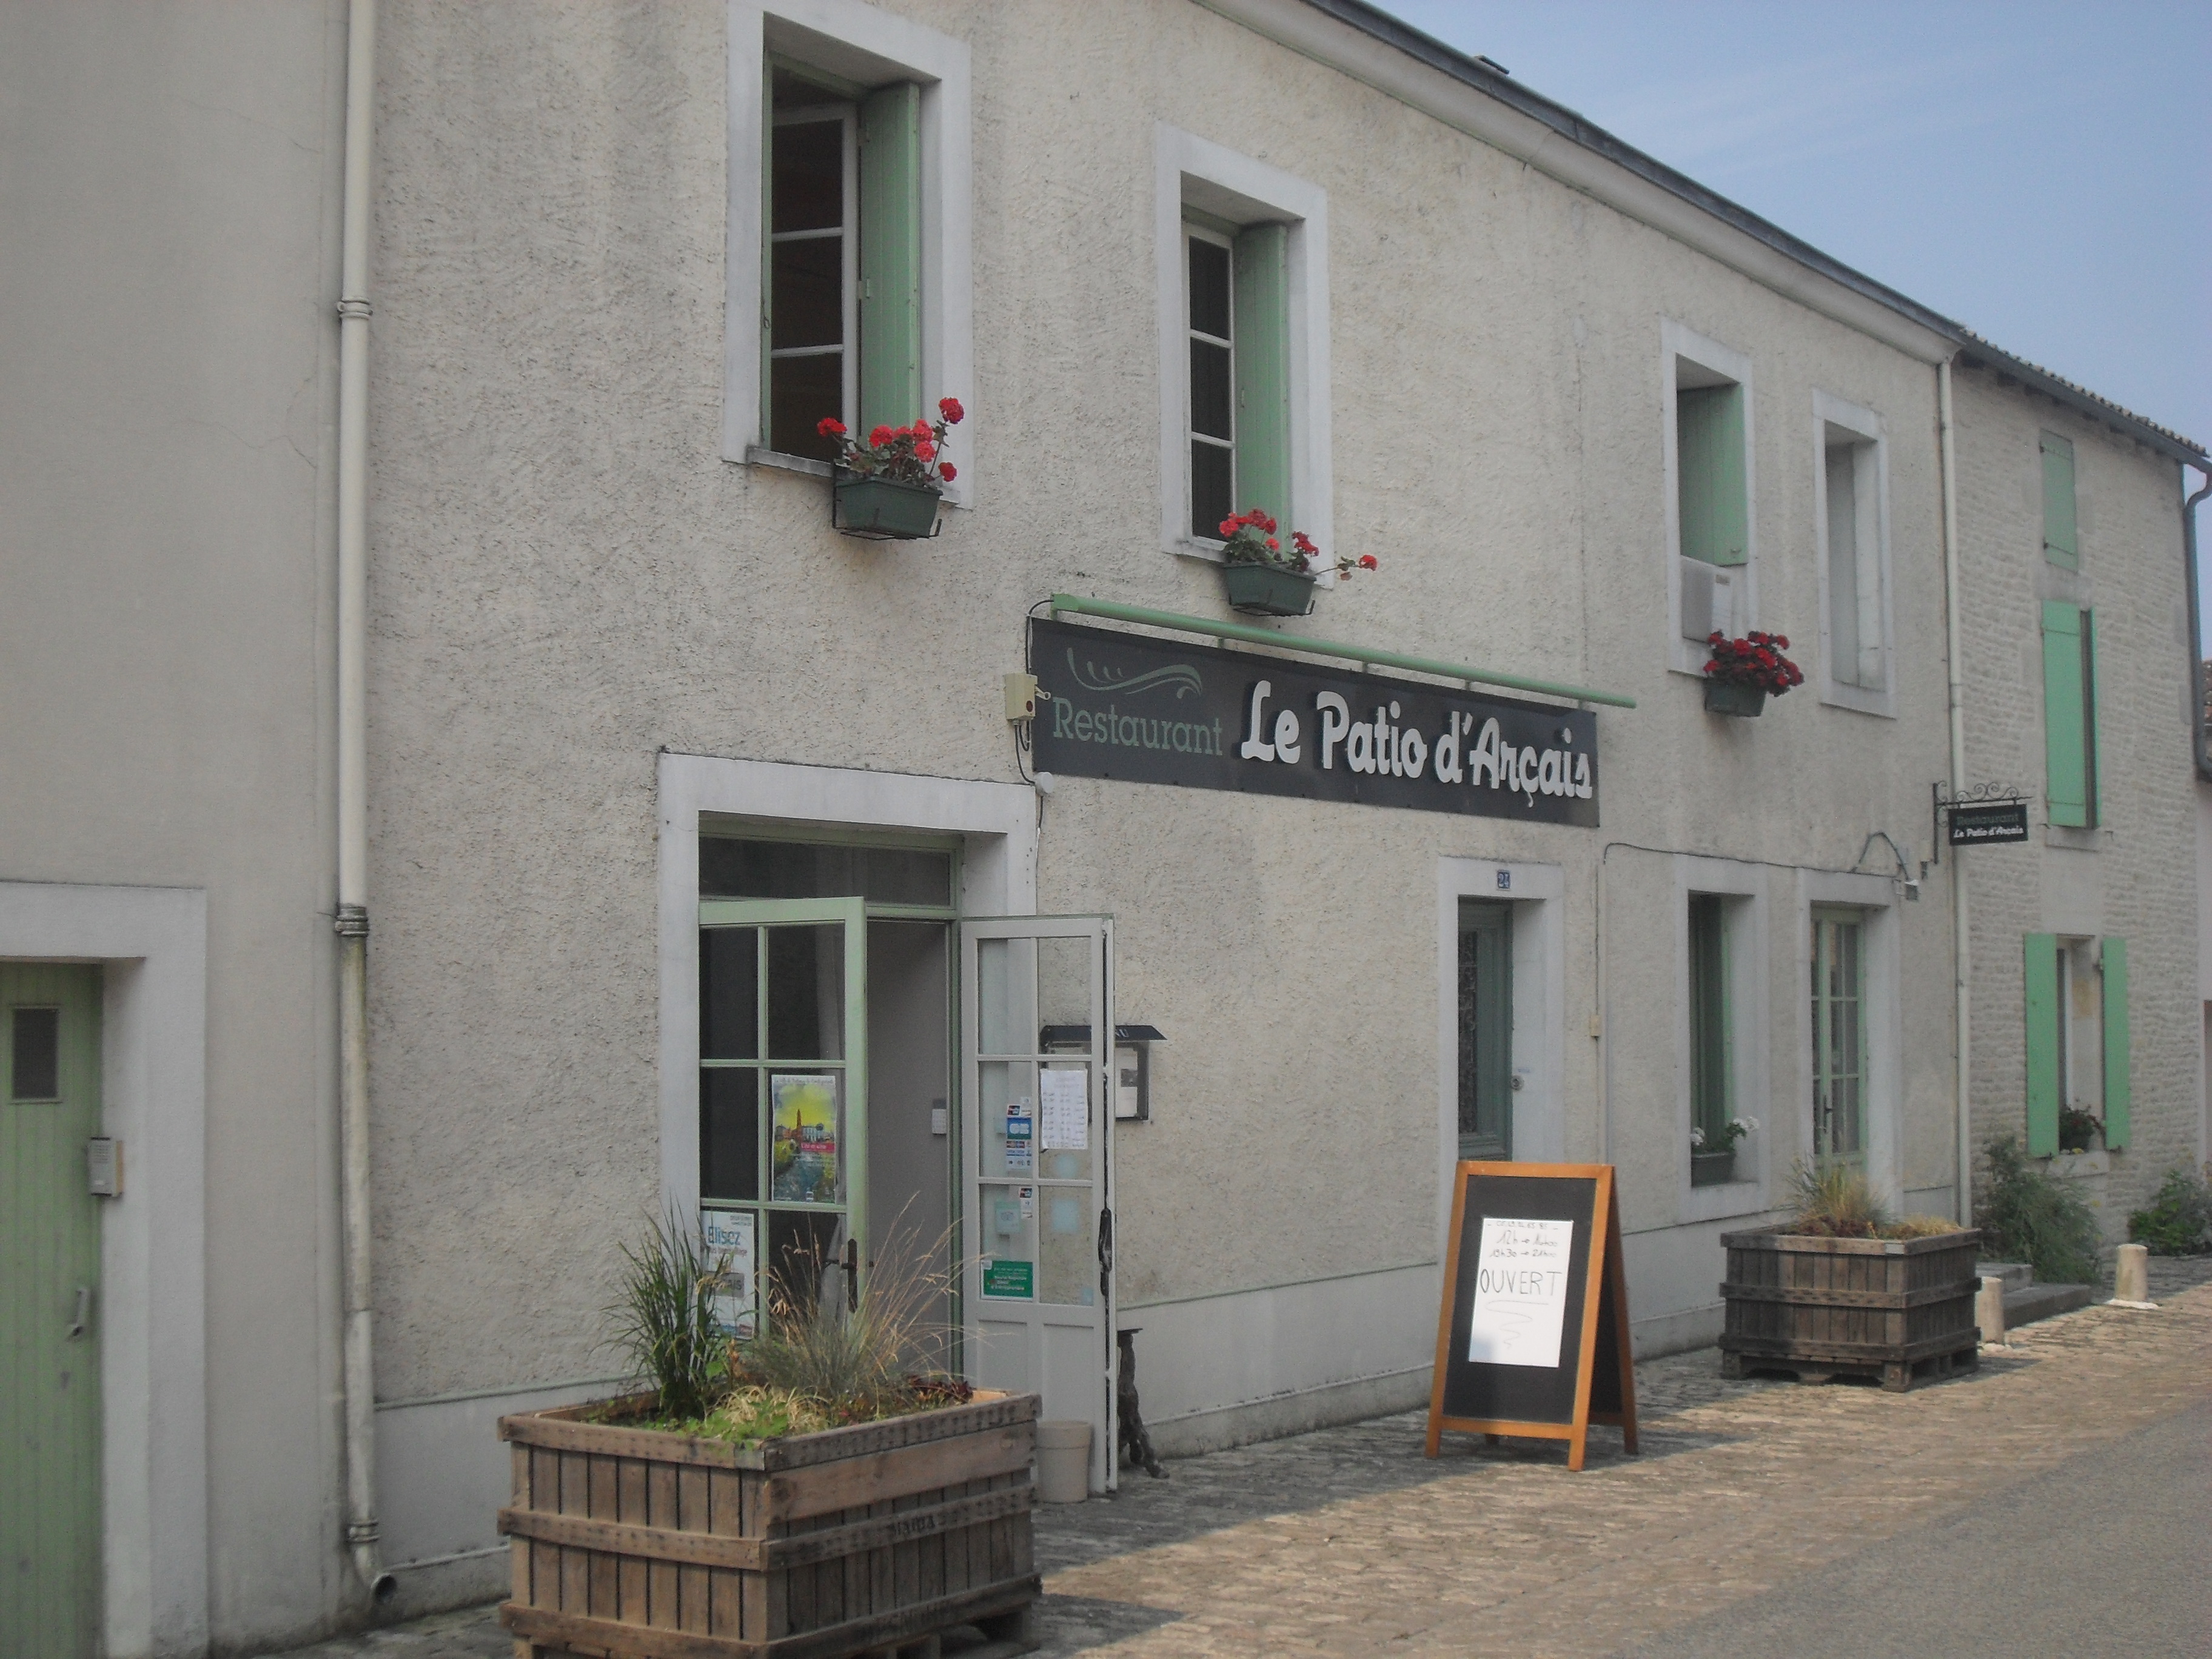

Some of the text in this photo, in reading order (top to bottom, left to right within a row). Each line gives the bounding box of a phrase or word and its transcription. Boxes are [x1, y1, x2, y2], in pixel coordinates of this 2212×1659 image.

[1053, 697, 1223, 756] Restaurant
[1241, 680, 1593, 808] Le Patio d'Arçais
[1480, 1269, 1563, 1296] OUVERT
